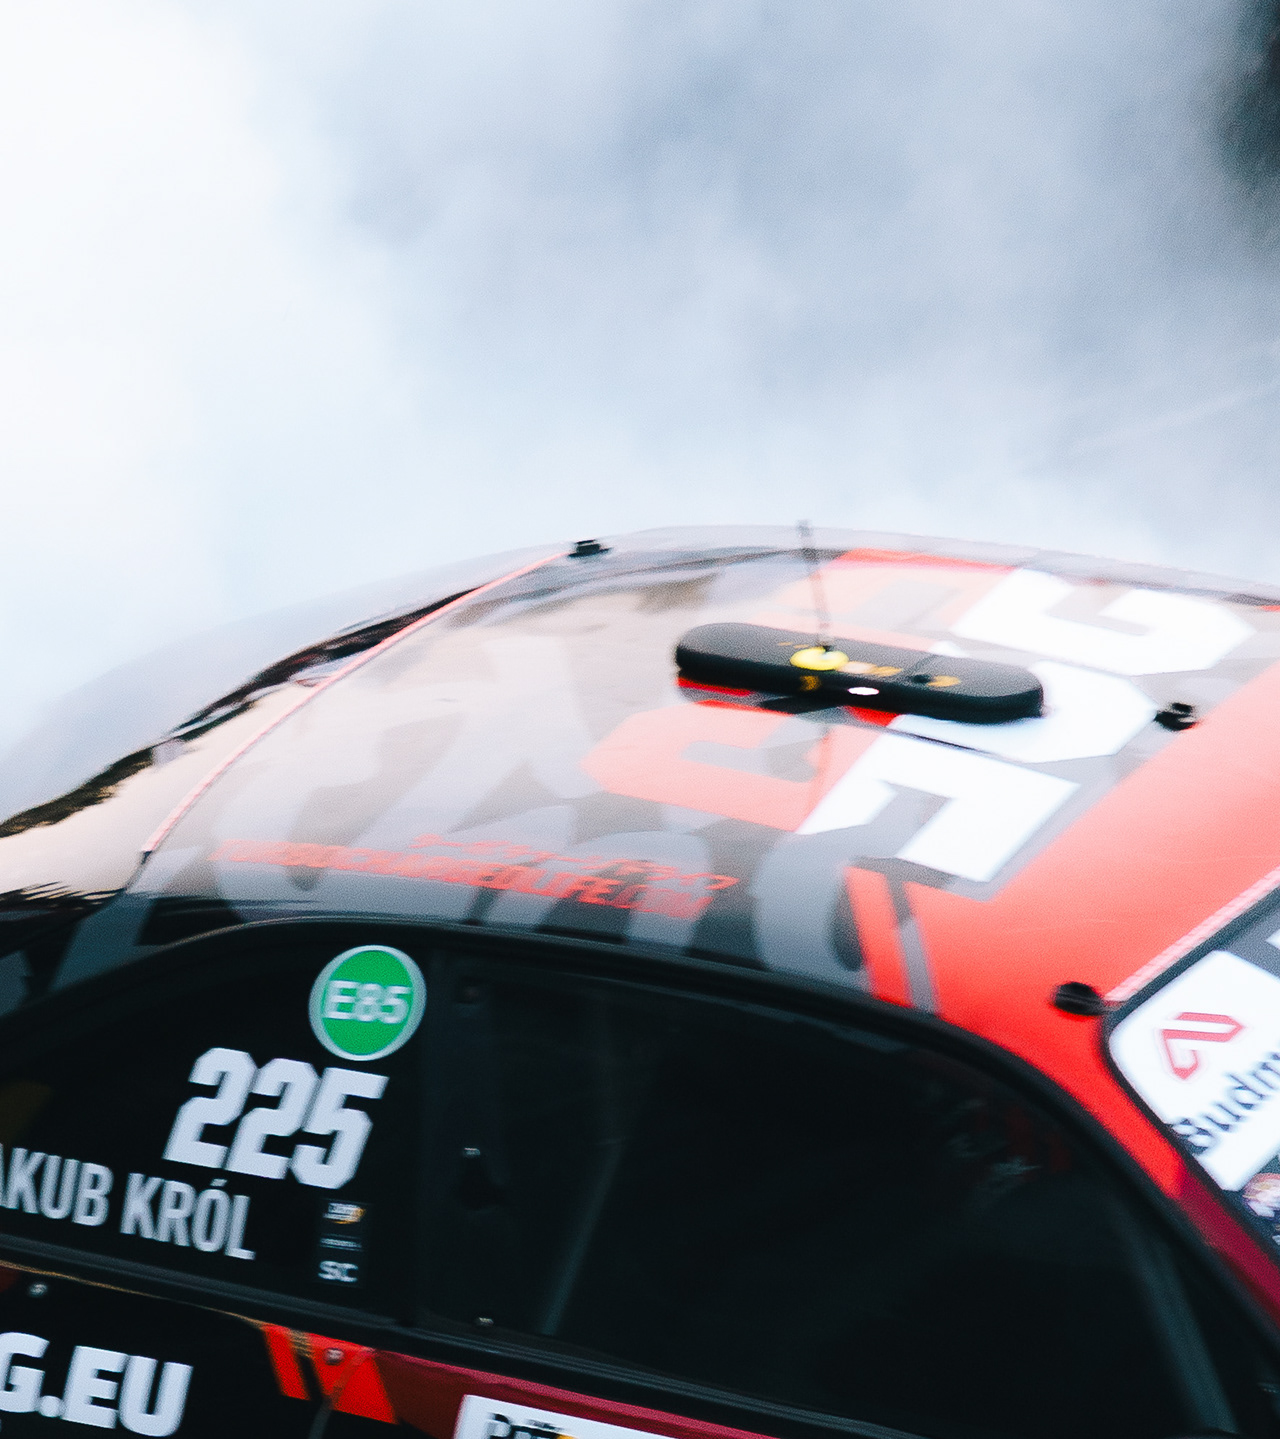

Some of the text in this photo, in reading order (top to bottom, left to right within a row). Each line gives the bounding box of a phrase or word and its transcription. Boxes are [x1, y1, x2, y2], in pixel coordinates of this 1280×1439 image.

[322, 975, 407, 1027] E85
[163, 1048, 388, 1190] 225
[121, 1179, 255, 1261] KRÓL
